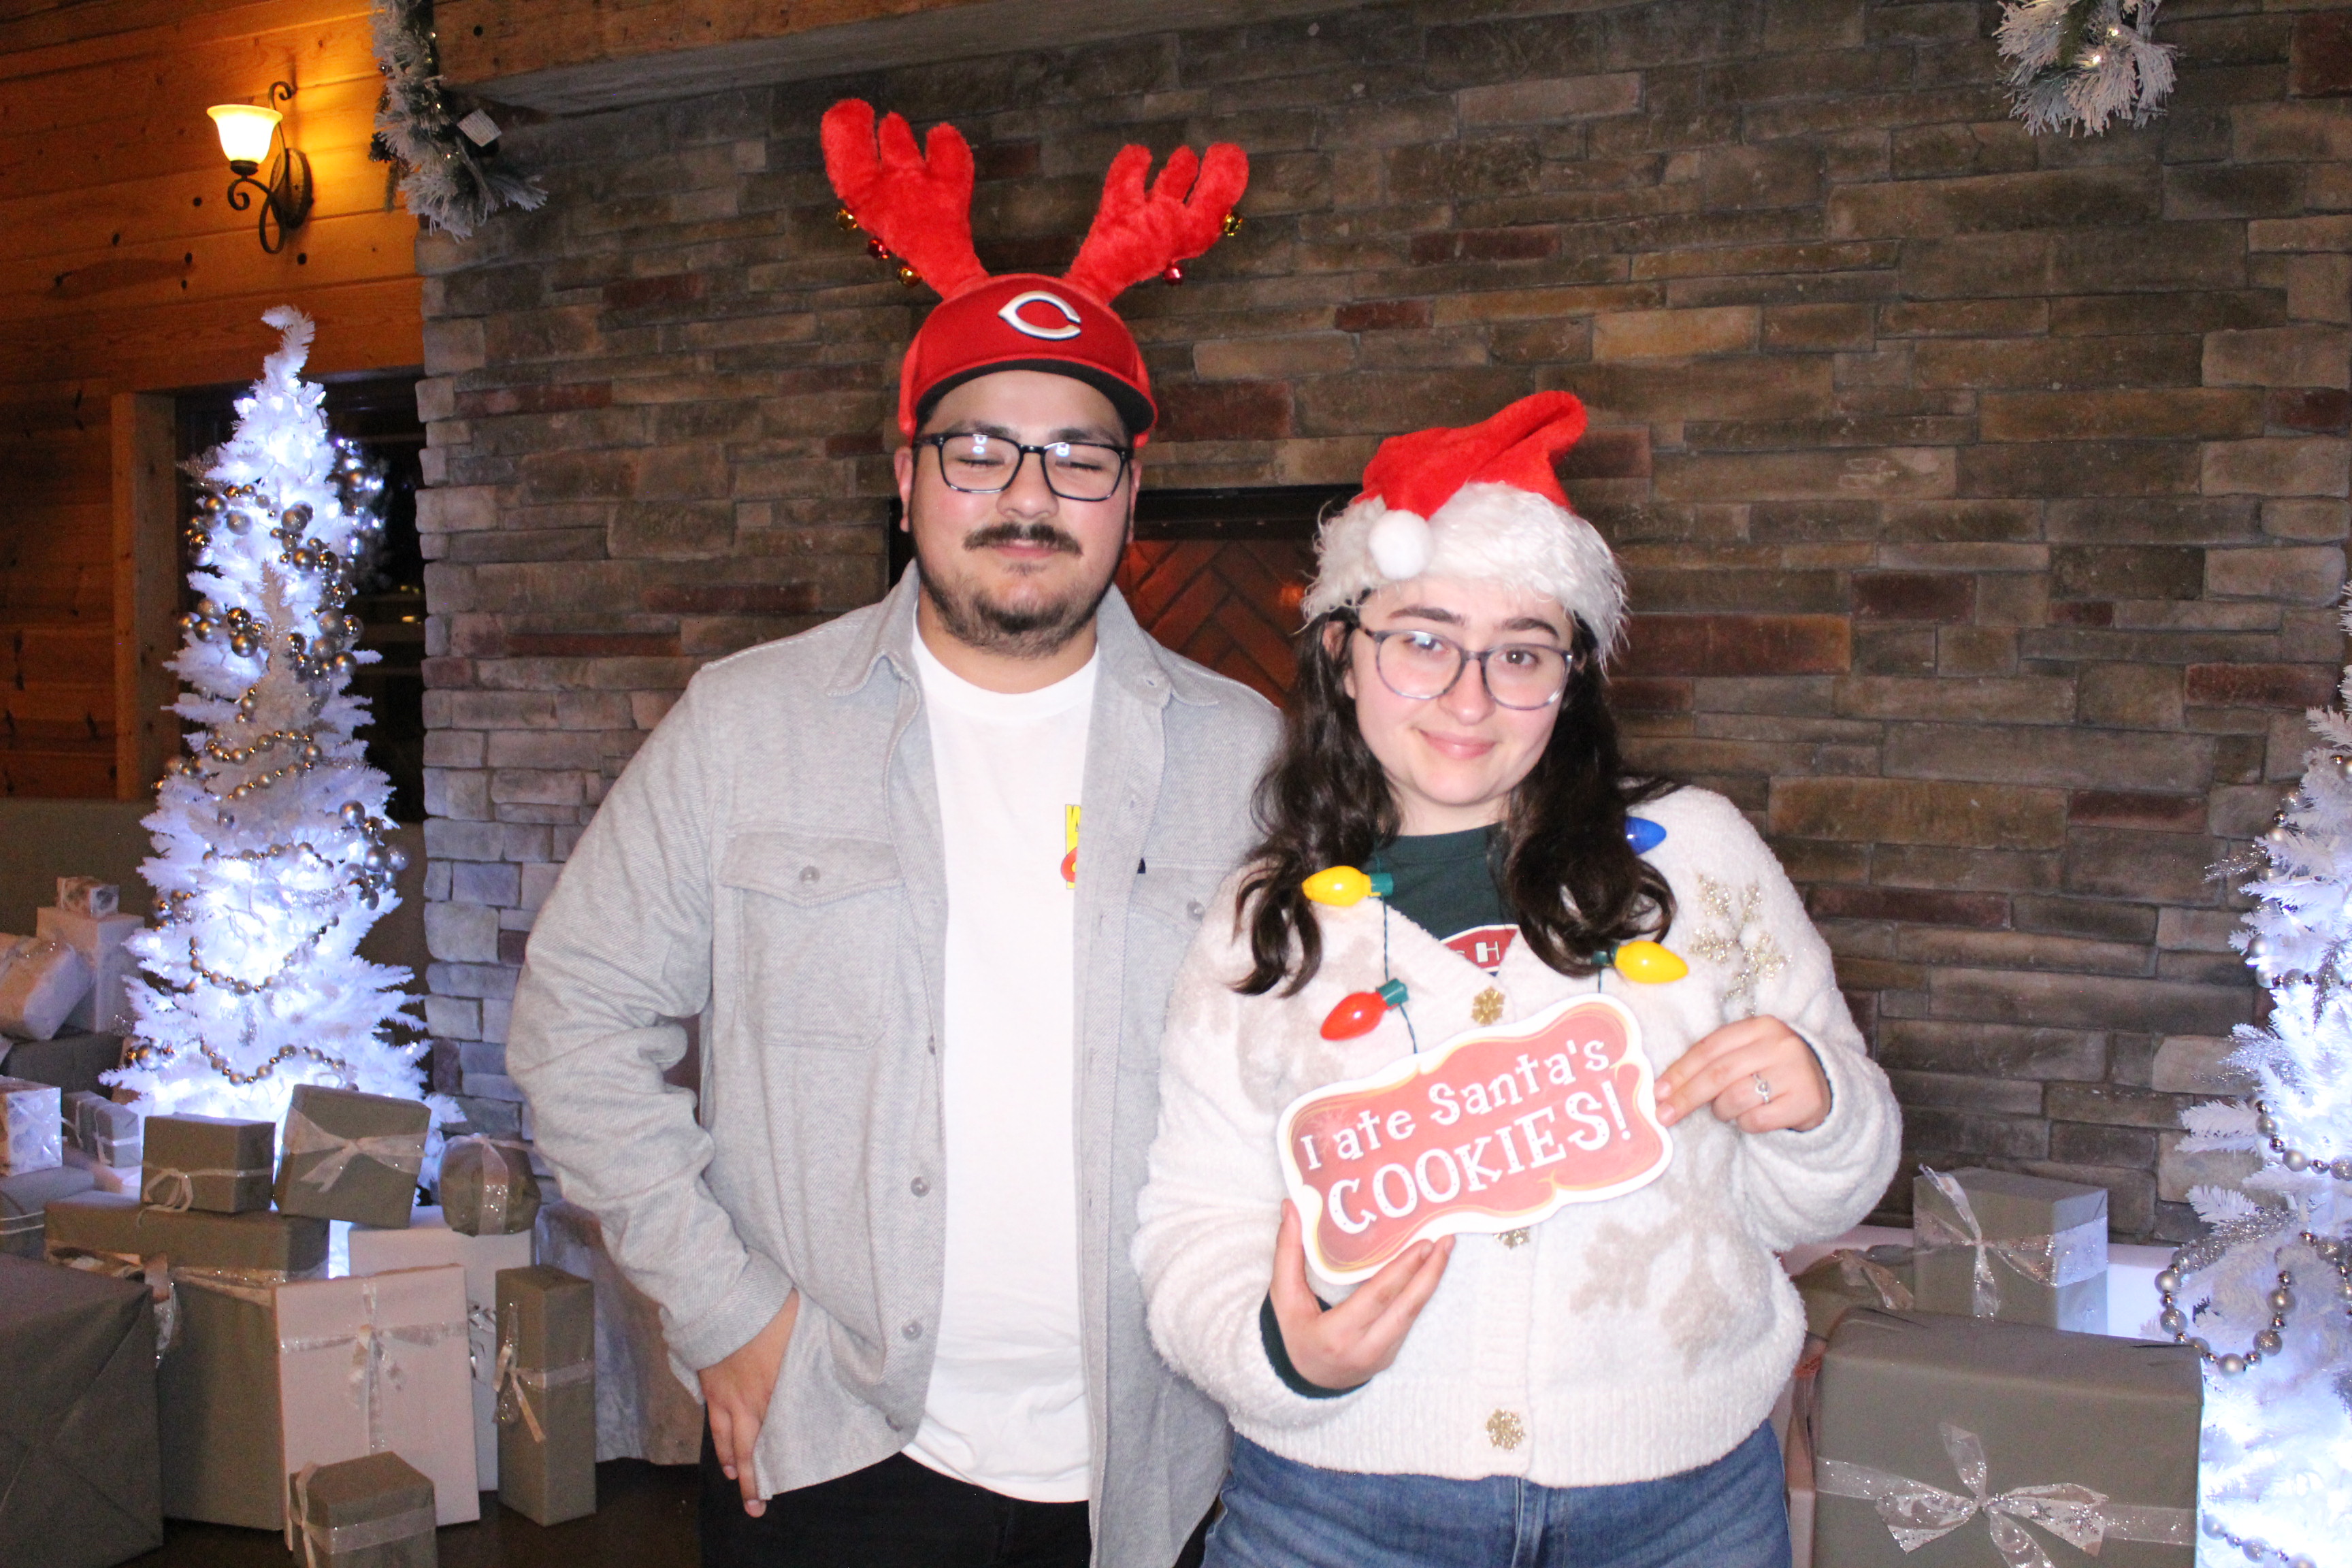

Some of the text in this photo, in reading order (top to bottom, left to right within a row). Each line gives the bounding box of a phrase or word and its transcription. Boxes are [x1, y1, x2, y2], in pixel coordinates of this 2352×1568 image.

[998, 290, 1081, 341] C
[1300, 1039, 1610, 1170] I ate Santa's
[1328, 1081, 1631, 1234] COOKIES!
